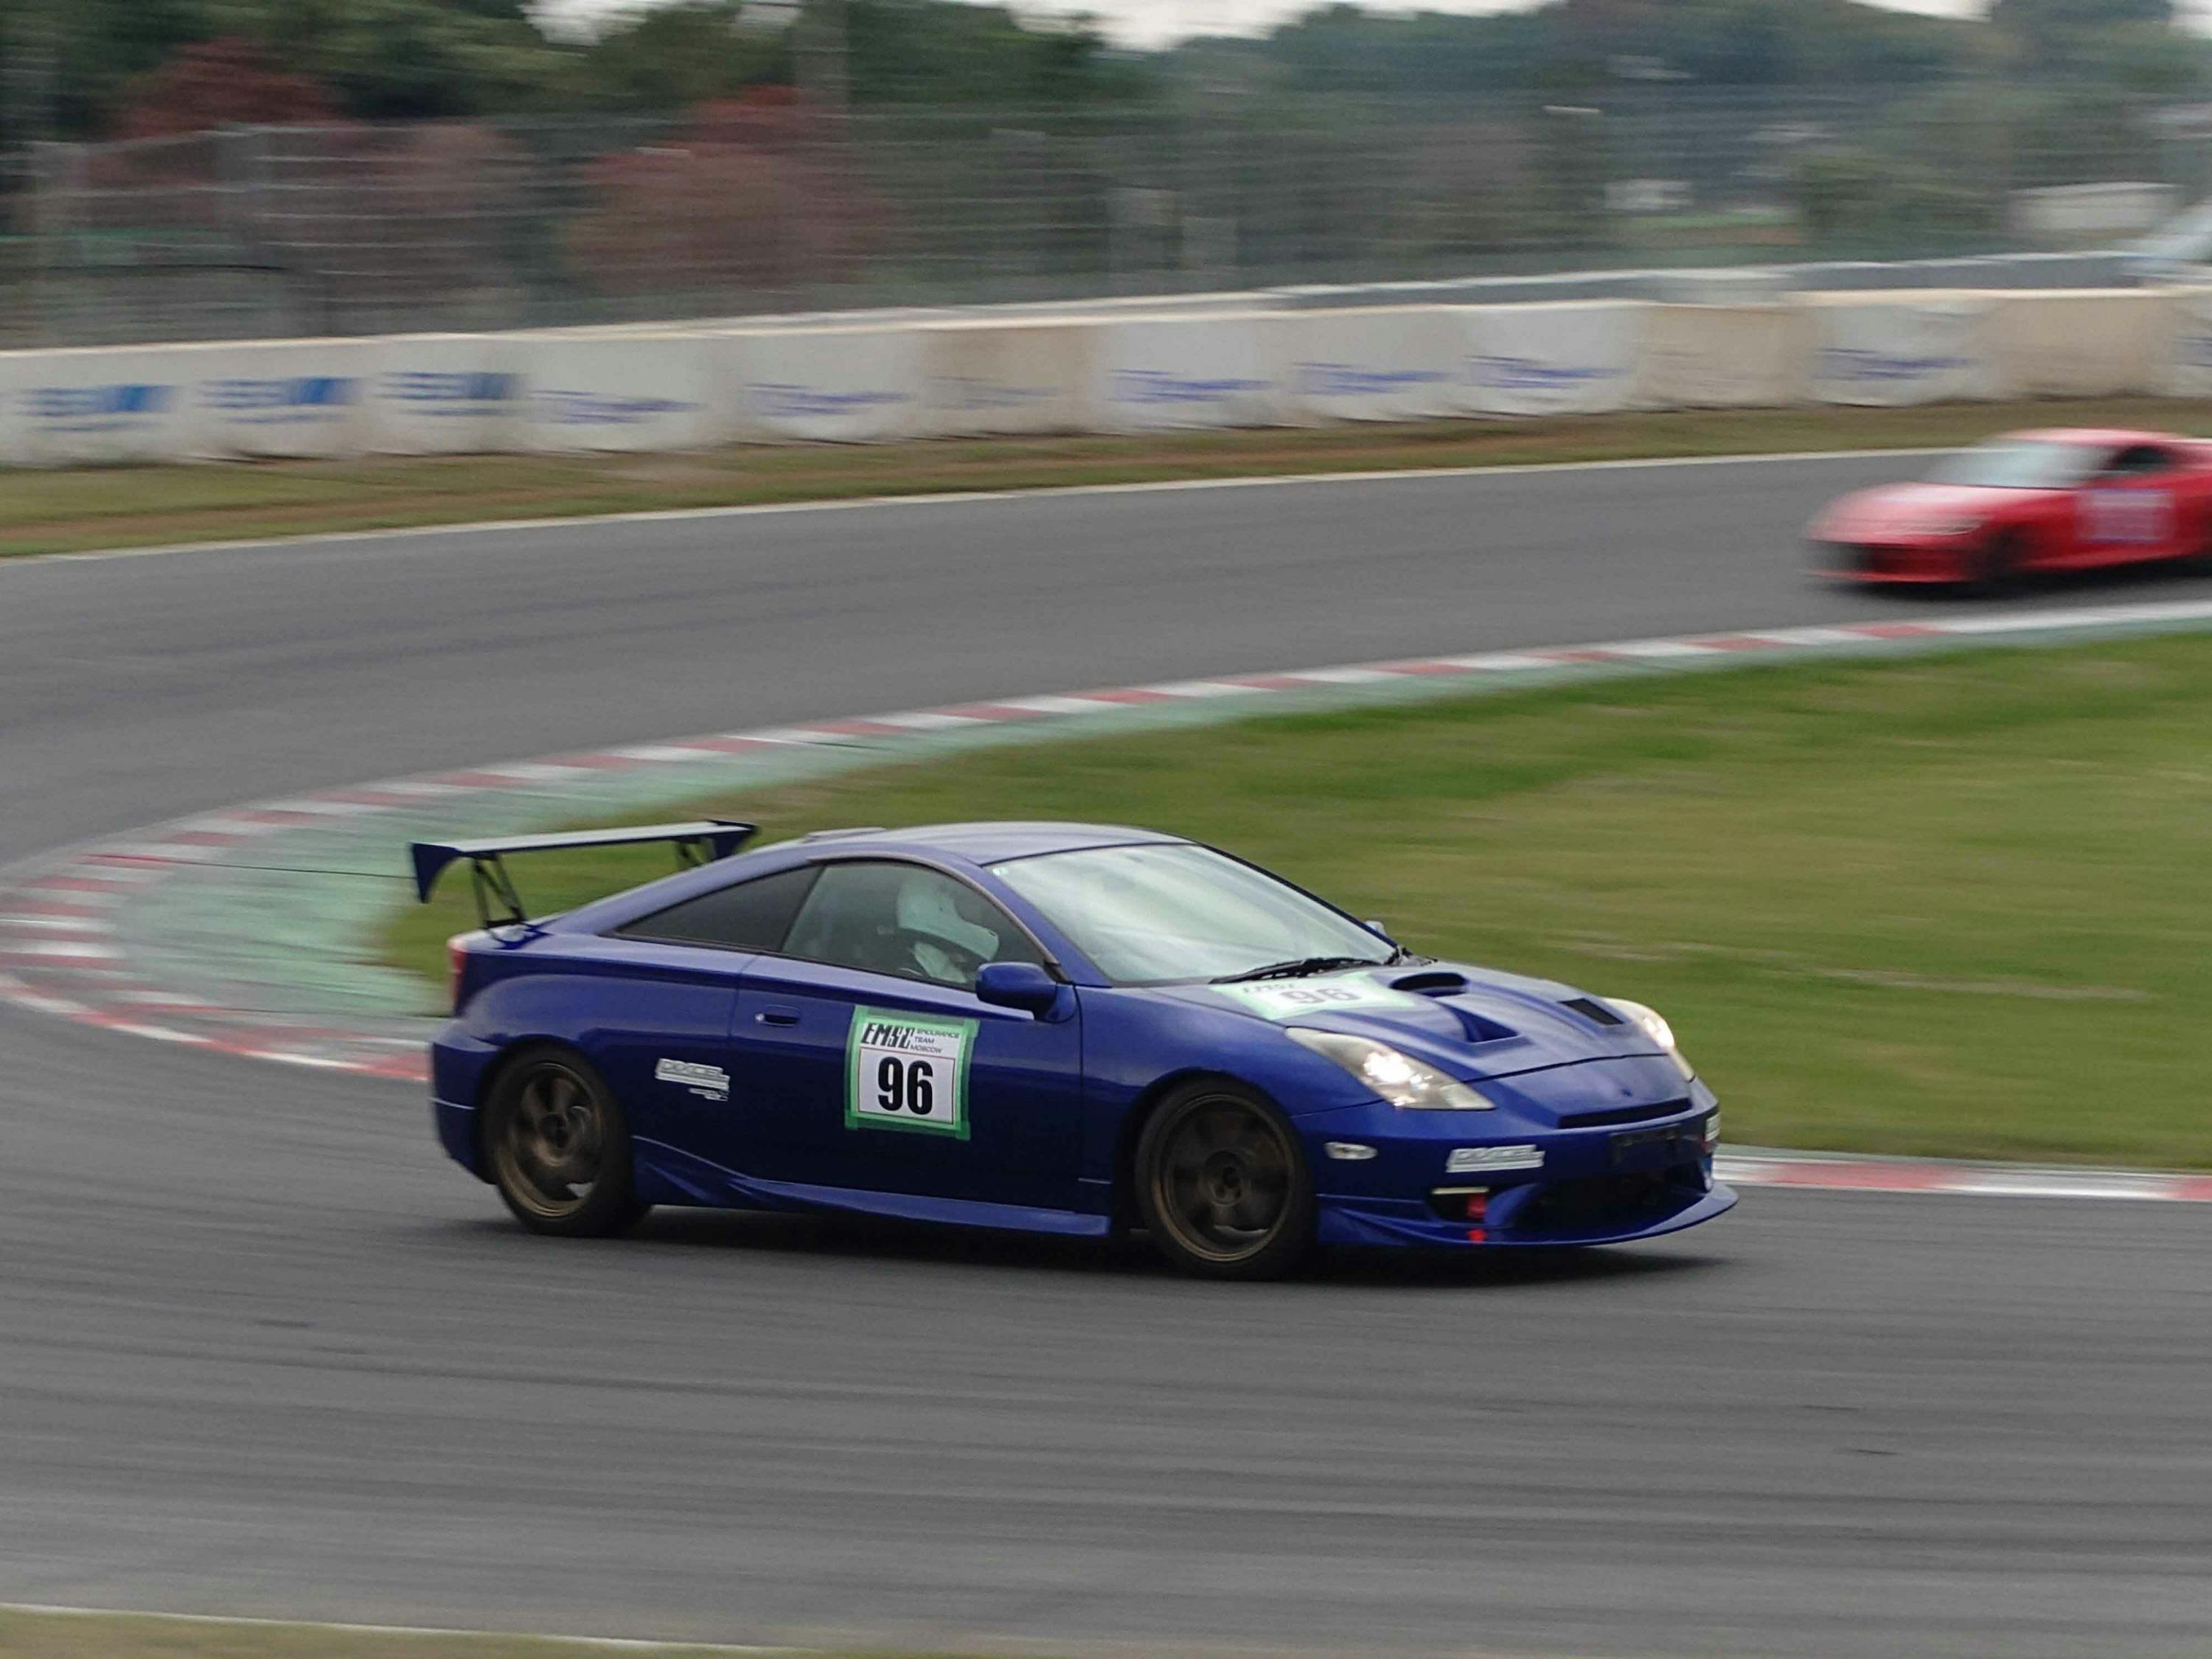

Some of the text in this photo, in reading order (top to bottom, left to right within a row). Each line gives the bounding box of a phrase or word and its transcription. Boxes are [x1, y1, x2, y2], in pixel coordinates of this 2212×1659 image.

[1281, 989, 1360, 1004] 96
[917, 1029, 959, 1038] ENDURANCE
[914, 1036, 935, 1045] TEAM
[911, 1045, 942, 1054] MOSCOW
[878, 1057, 933, 1115] 96
